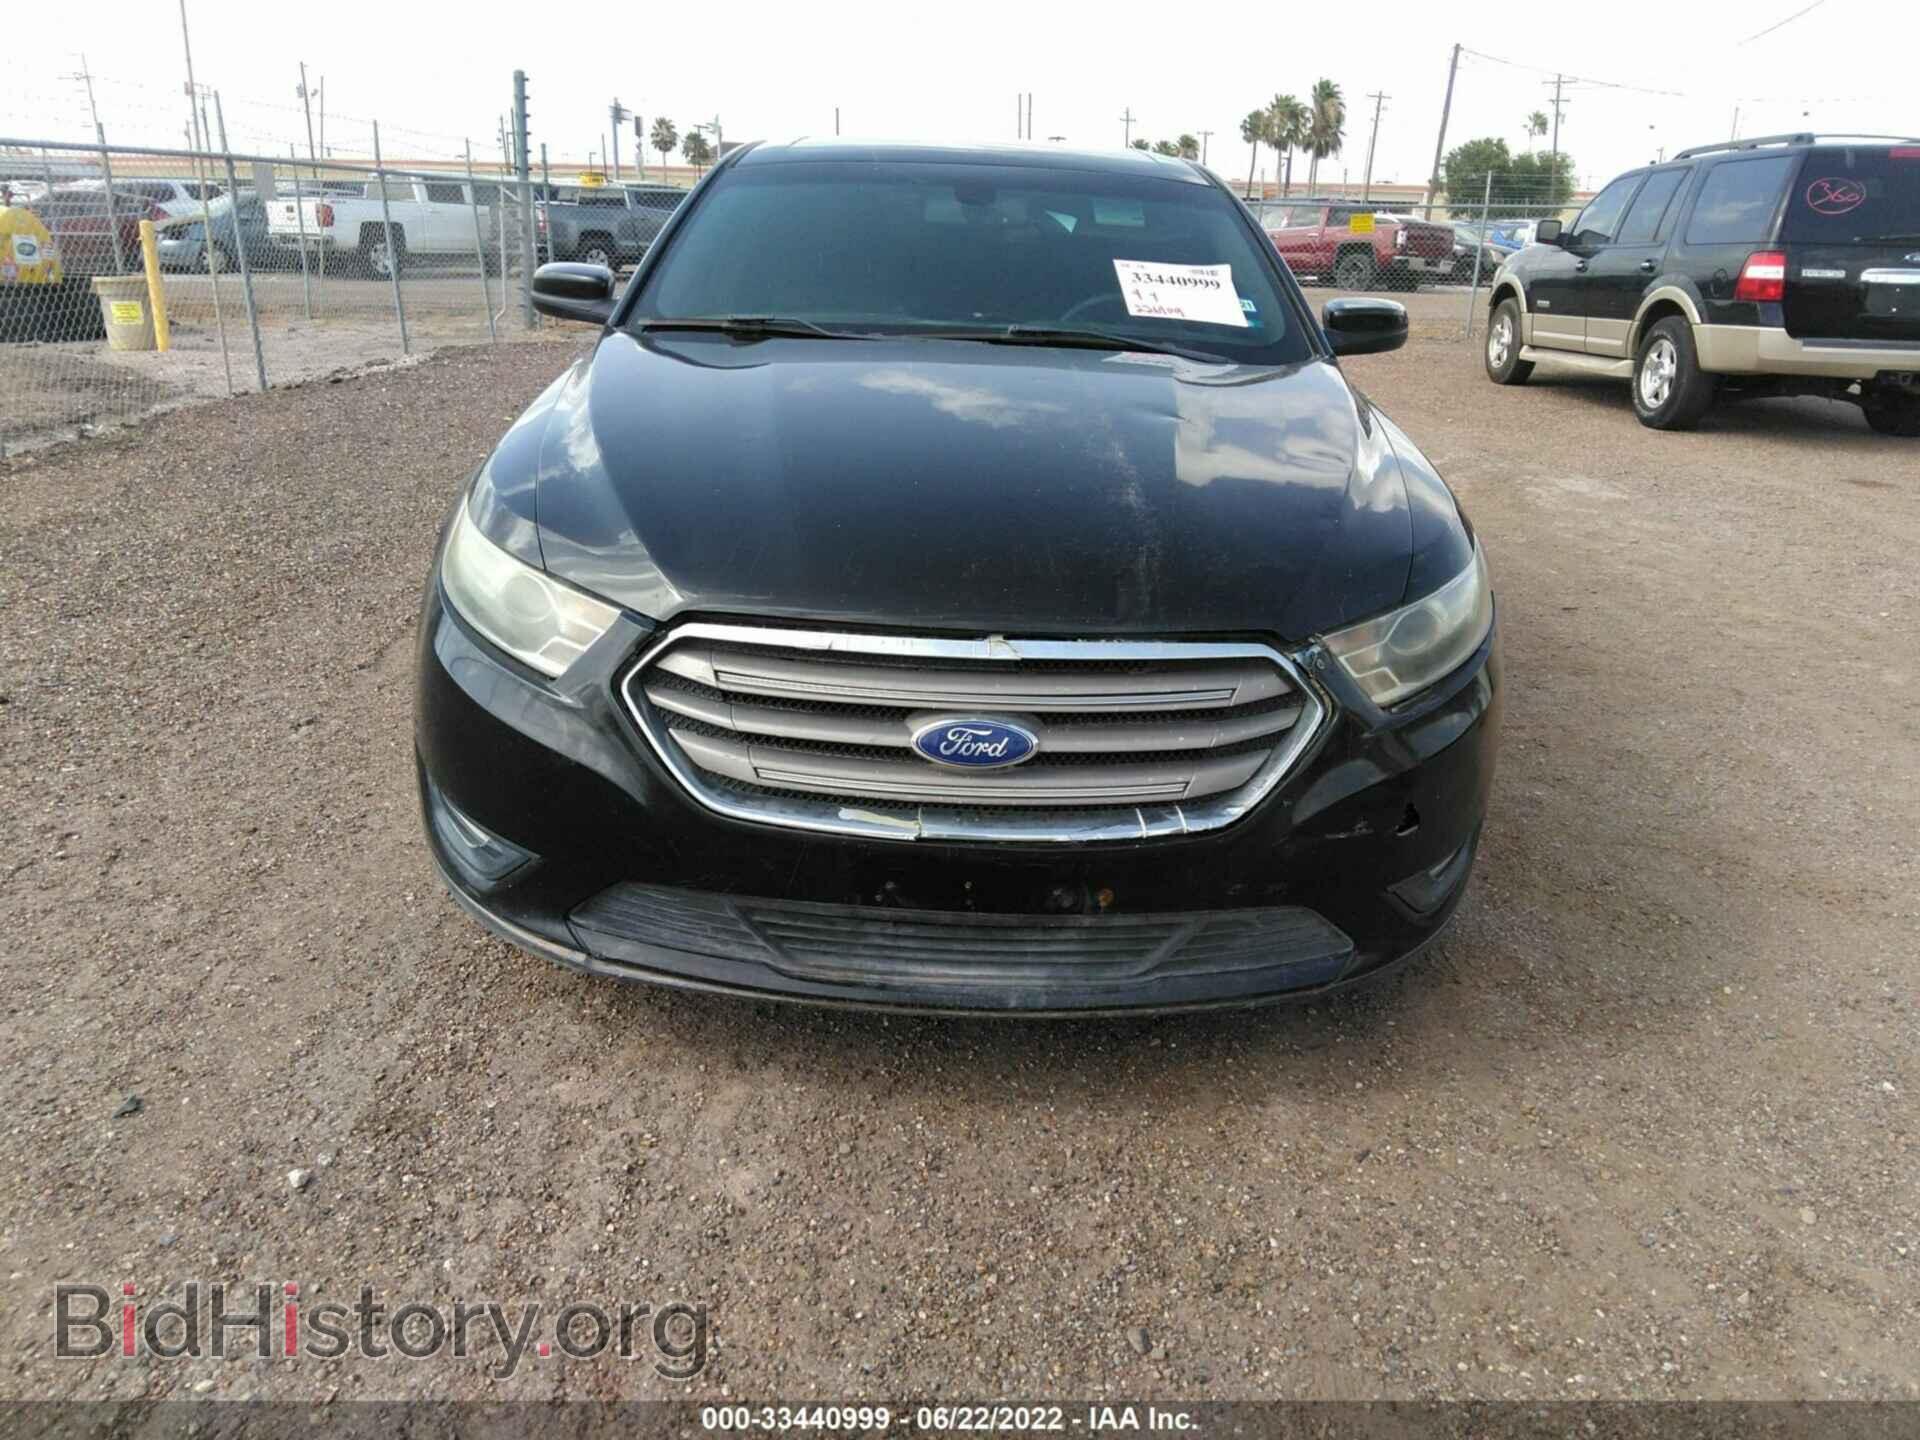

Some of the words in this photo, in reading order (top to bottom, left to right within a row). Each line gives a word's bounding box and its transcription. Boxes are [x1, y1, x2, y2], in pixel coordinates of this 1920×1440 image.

[1814, 181, 1860, 205] 360
[1132, 271, 1221, 289] 33440999
[939, 727, 1009, 757] Ford
